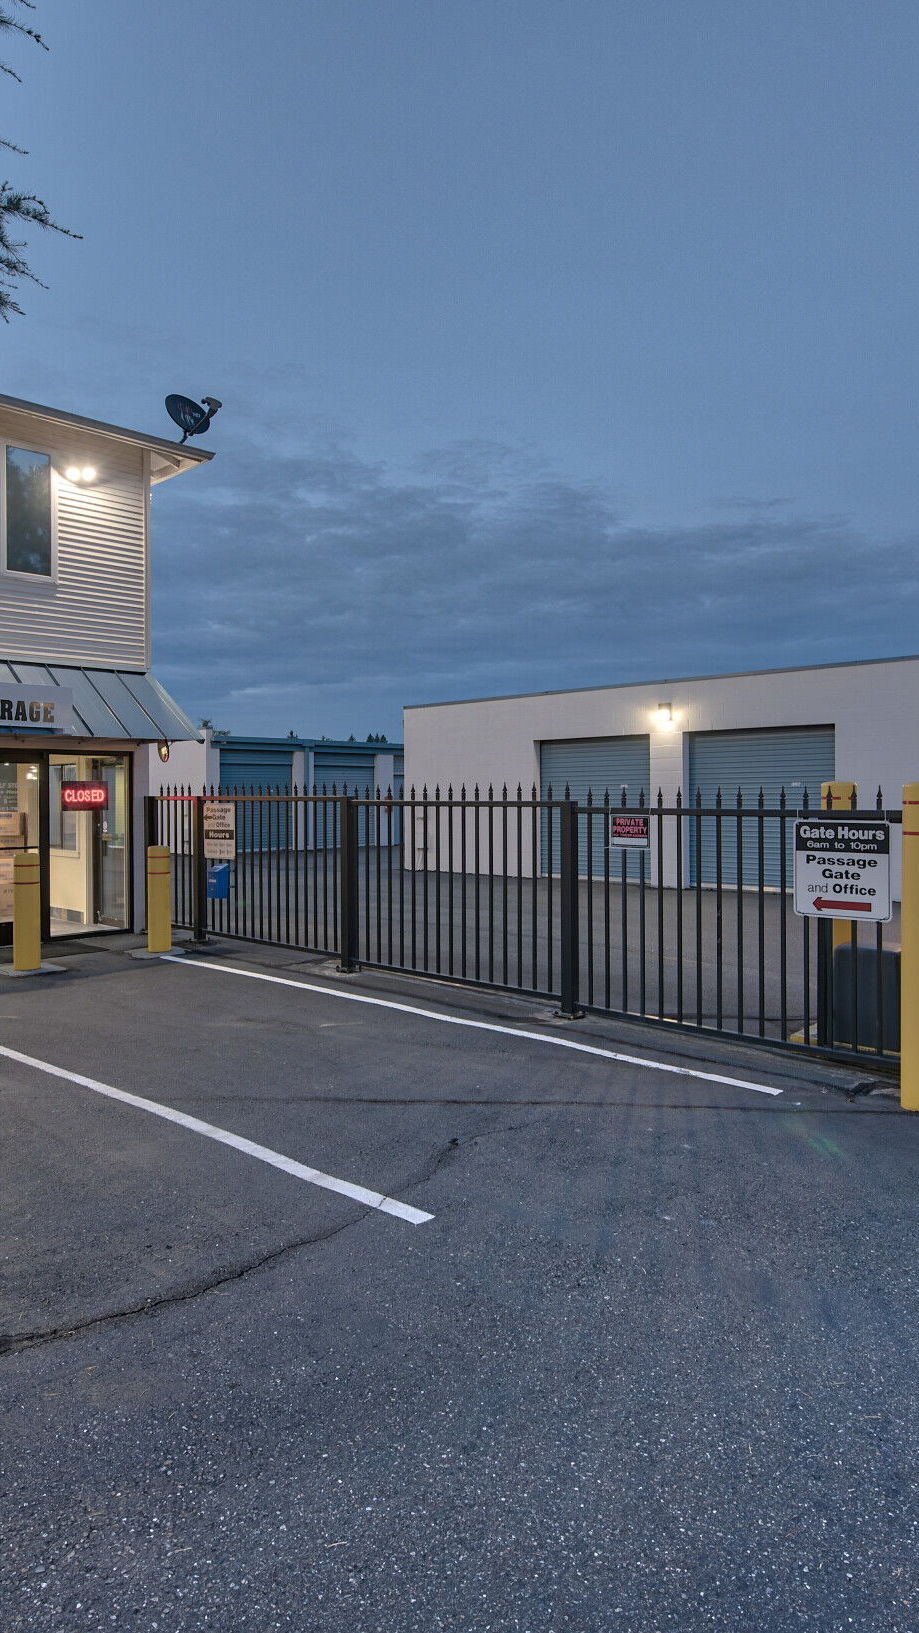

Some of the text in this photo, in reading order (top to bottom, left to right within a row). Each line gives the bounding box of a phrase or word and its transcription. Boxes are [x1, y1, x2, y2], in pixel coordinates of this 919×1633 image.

[64, 789, 105, 802] CLOSED
[616, 818, 644, 826] PRIVATE
[208, 830, 230, 839] Hours
[612, 826, 647, 834] PROPERTY
[800, 826, 885, 840] Gate Hours
[806, 840, 878, 851] 6am to 10pm
[806, 854, 878, 869] Passage
[822, 868, 860, 880] Gate
[808, 884, 876, 896] and Office
